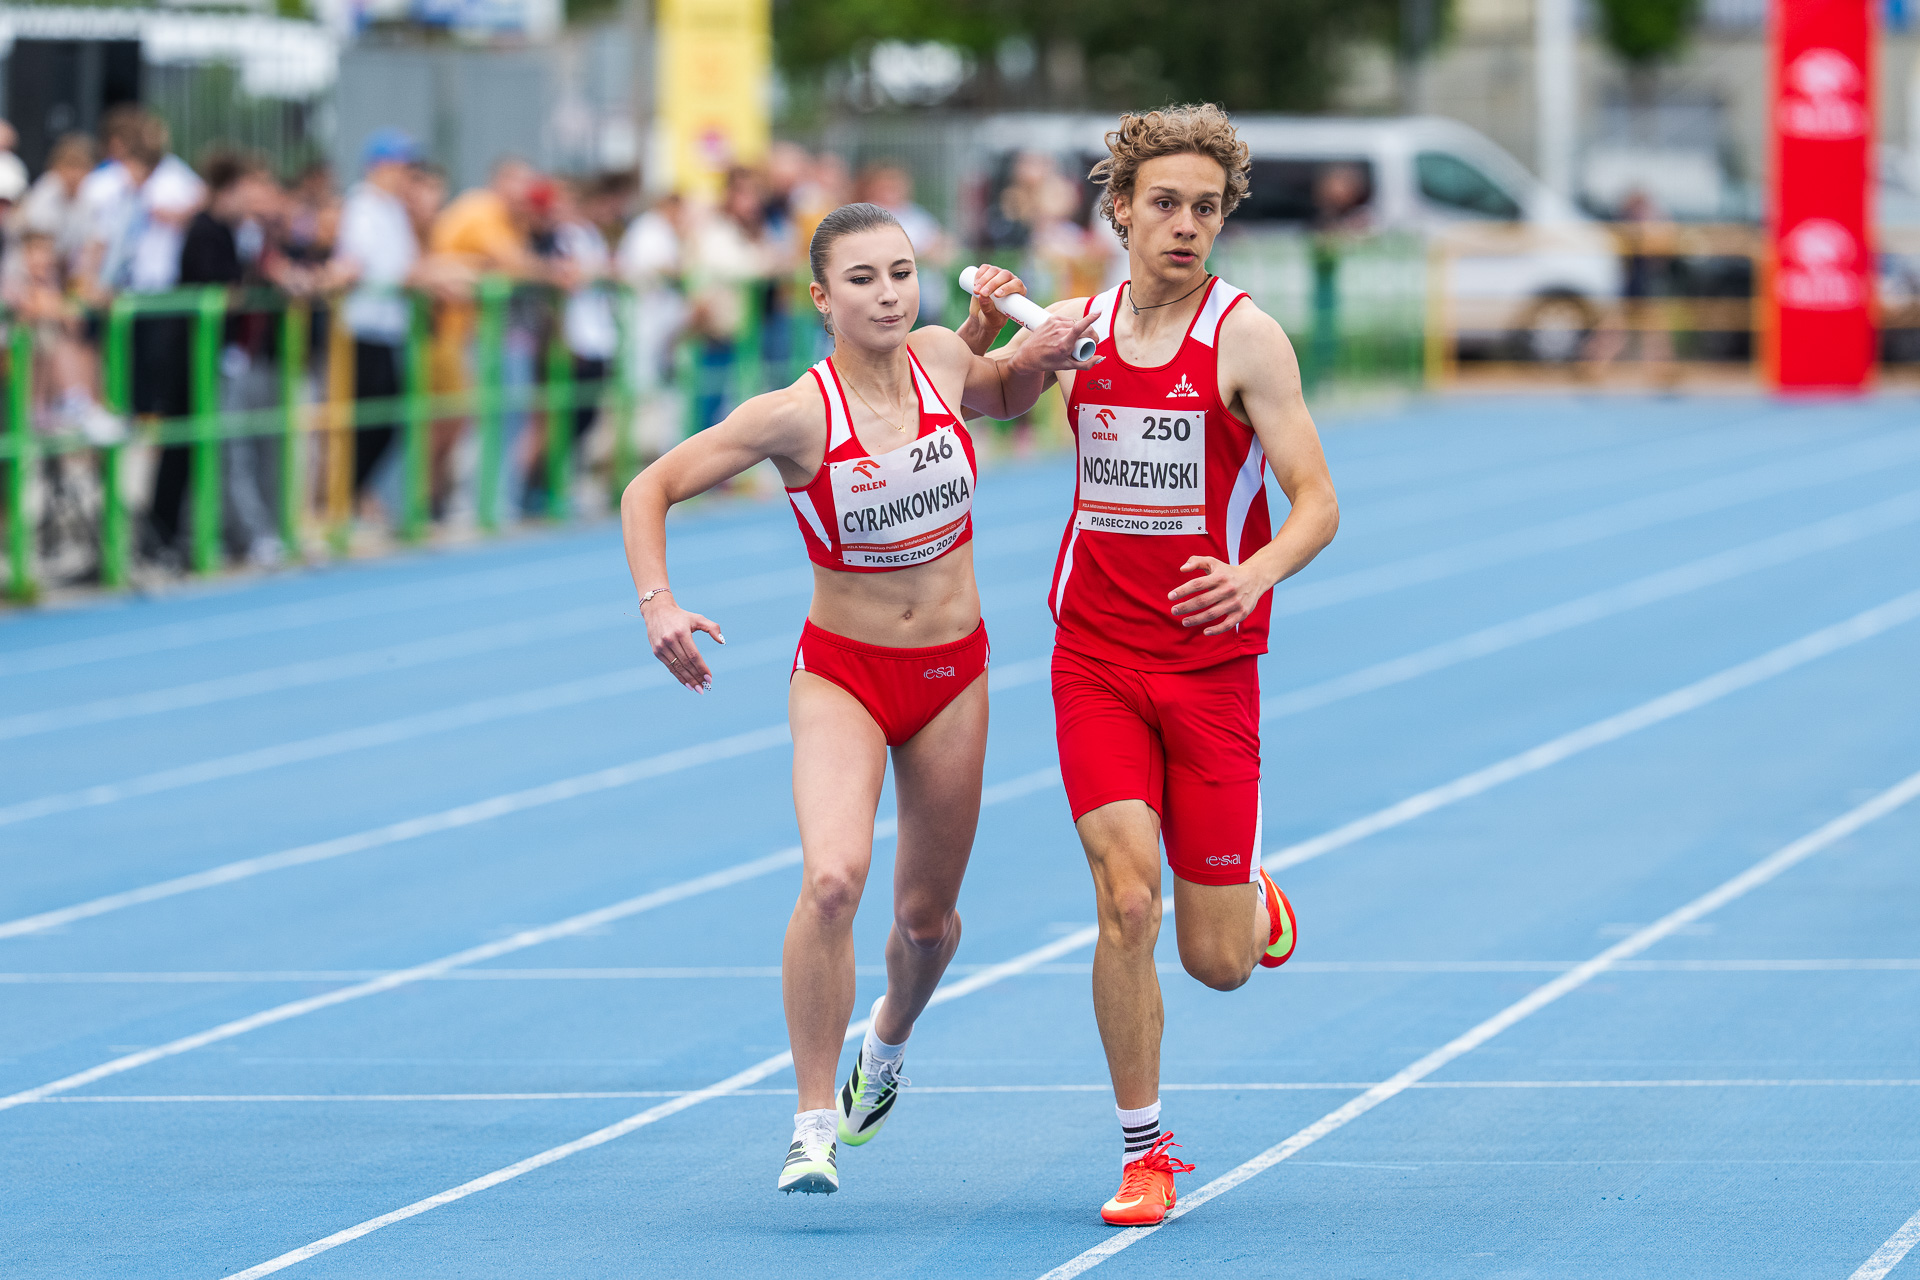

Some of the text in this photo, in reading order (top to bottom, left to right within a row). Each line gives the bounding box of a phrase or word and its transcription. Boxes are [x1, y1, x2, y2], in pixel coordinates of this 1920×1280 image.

[1086, 379, 1112, 390] esa
[1141, 416, 1191, 441] 250
[1092, 431, 1118, 441] ORLEN
[910, 435, 953, 473] 246
[1083, 456, 1198, 489] NOSARZEWSKI
[851, 480, 887, 494] ORLEN
[843, 476, 970, 533] CYRANKOWSKA
[1090, 516, 1183, 530] PIASECZNO 2026
[864, 532, 957, 563] PIASECZNO 2026
[923, 665, 955, 679] esa
[1205, 853, 1241, 866] esa
